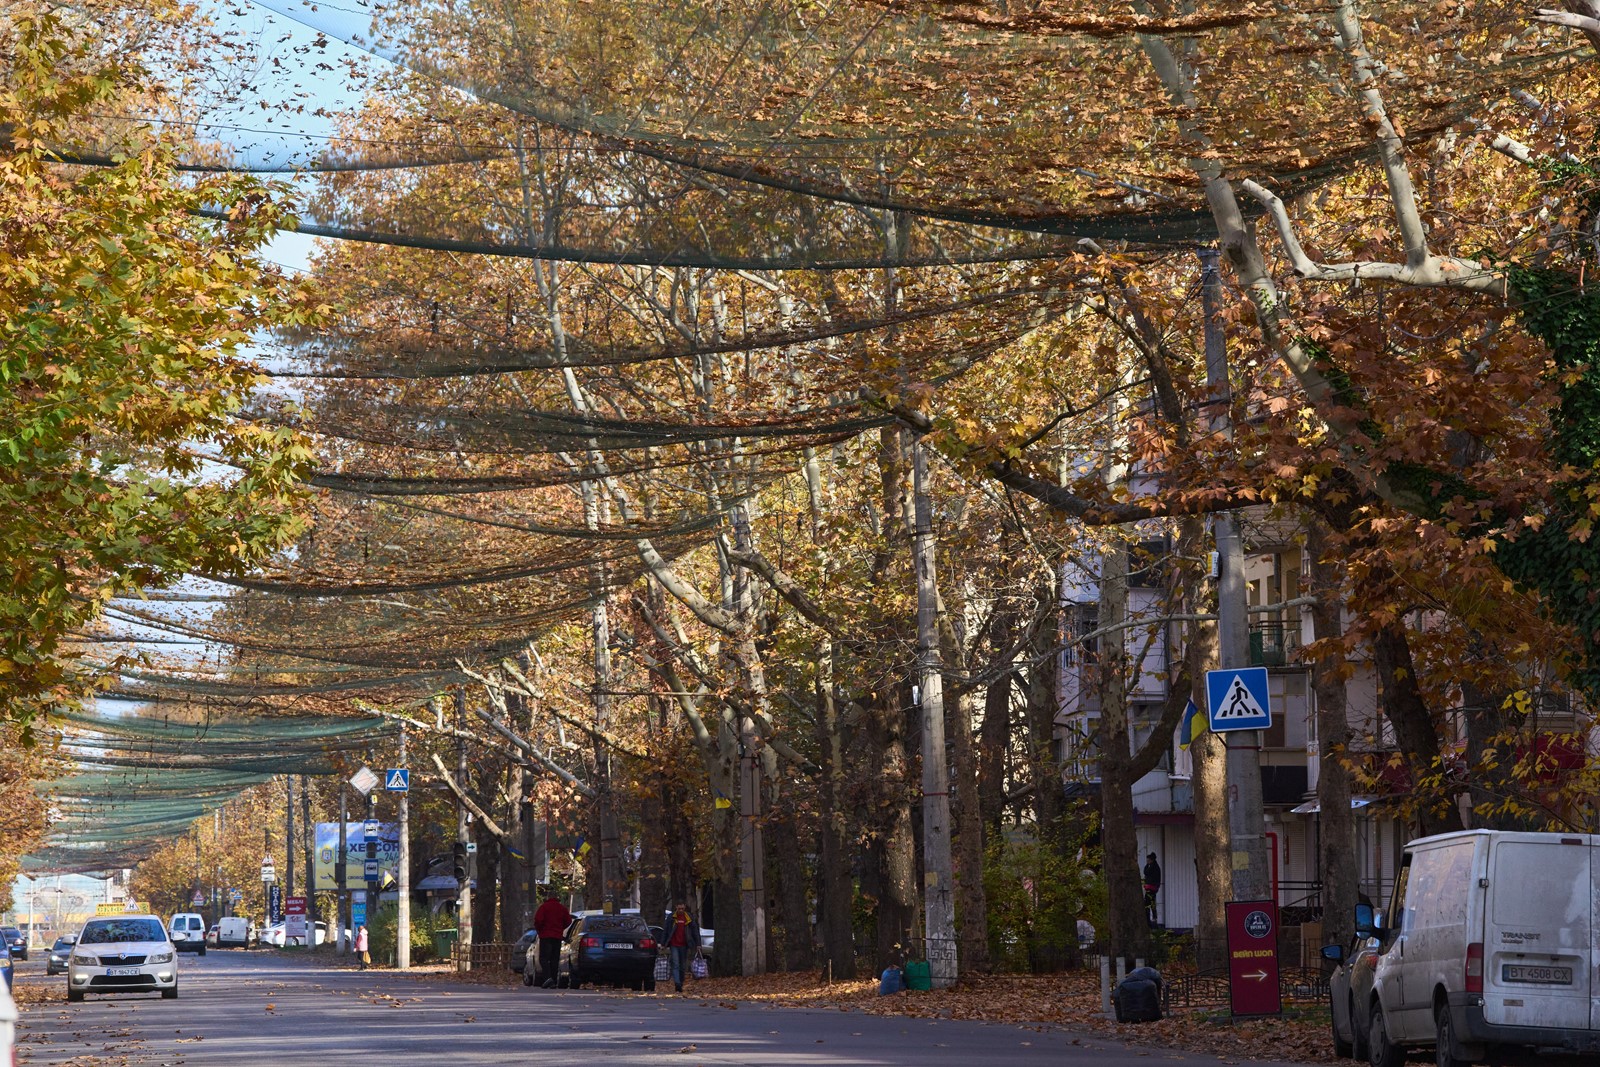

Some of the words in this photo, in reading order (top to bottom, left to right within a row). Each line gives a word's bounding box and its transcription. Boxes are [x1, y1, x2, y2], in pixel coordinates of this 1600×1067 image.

[349, 843, 399, 852] ХЕСОН
[1501, 932, 1540, 940] TRANSIT
[1510, 968, 1525, 978] BT
[1527, 969, 1551, 979] 4508
[1553, 969, 1569, 980] CX
